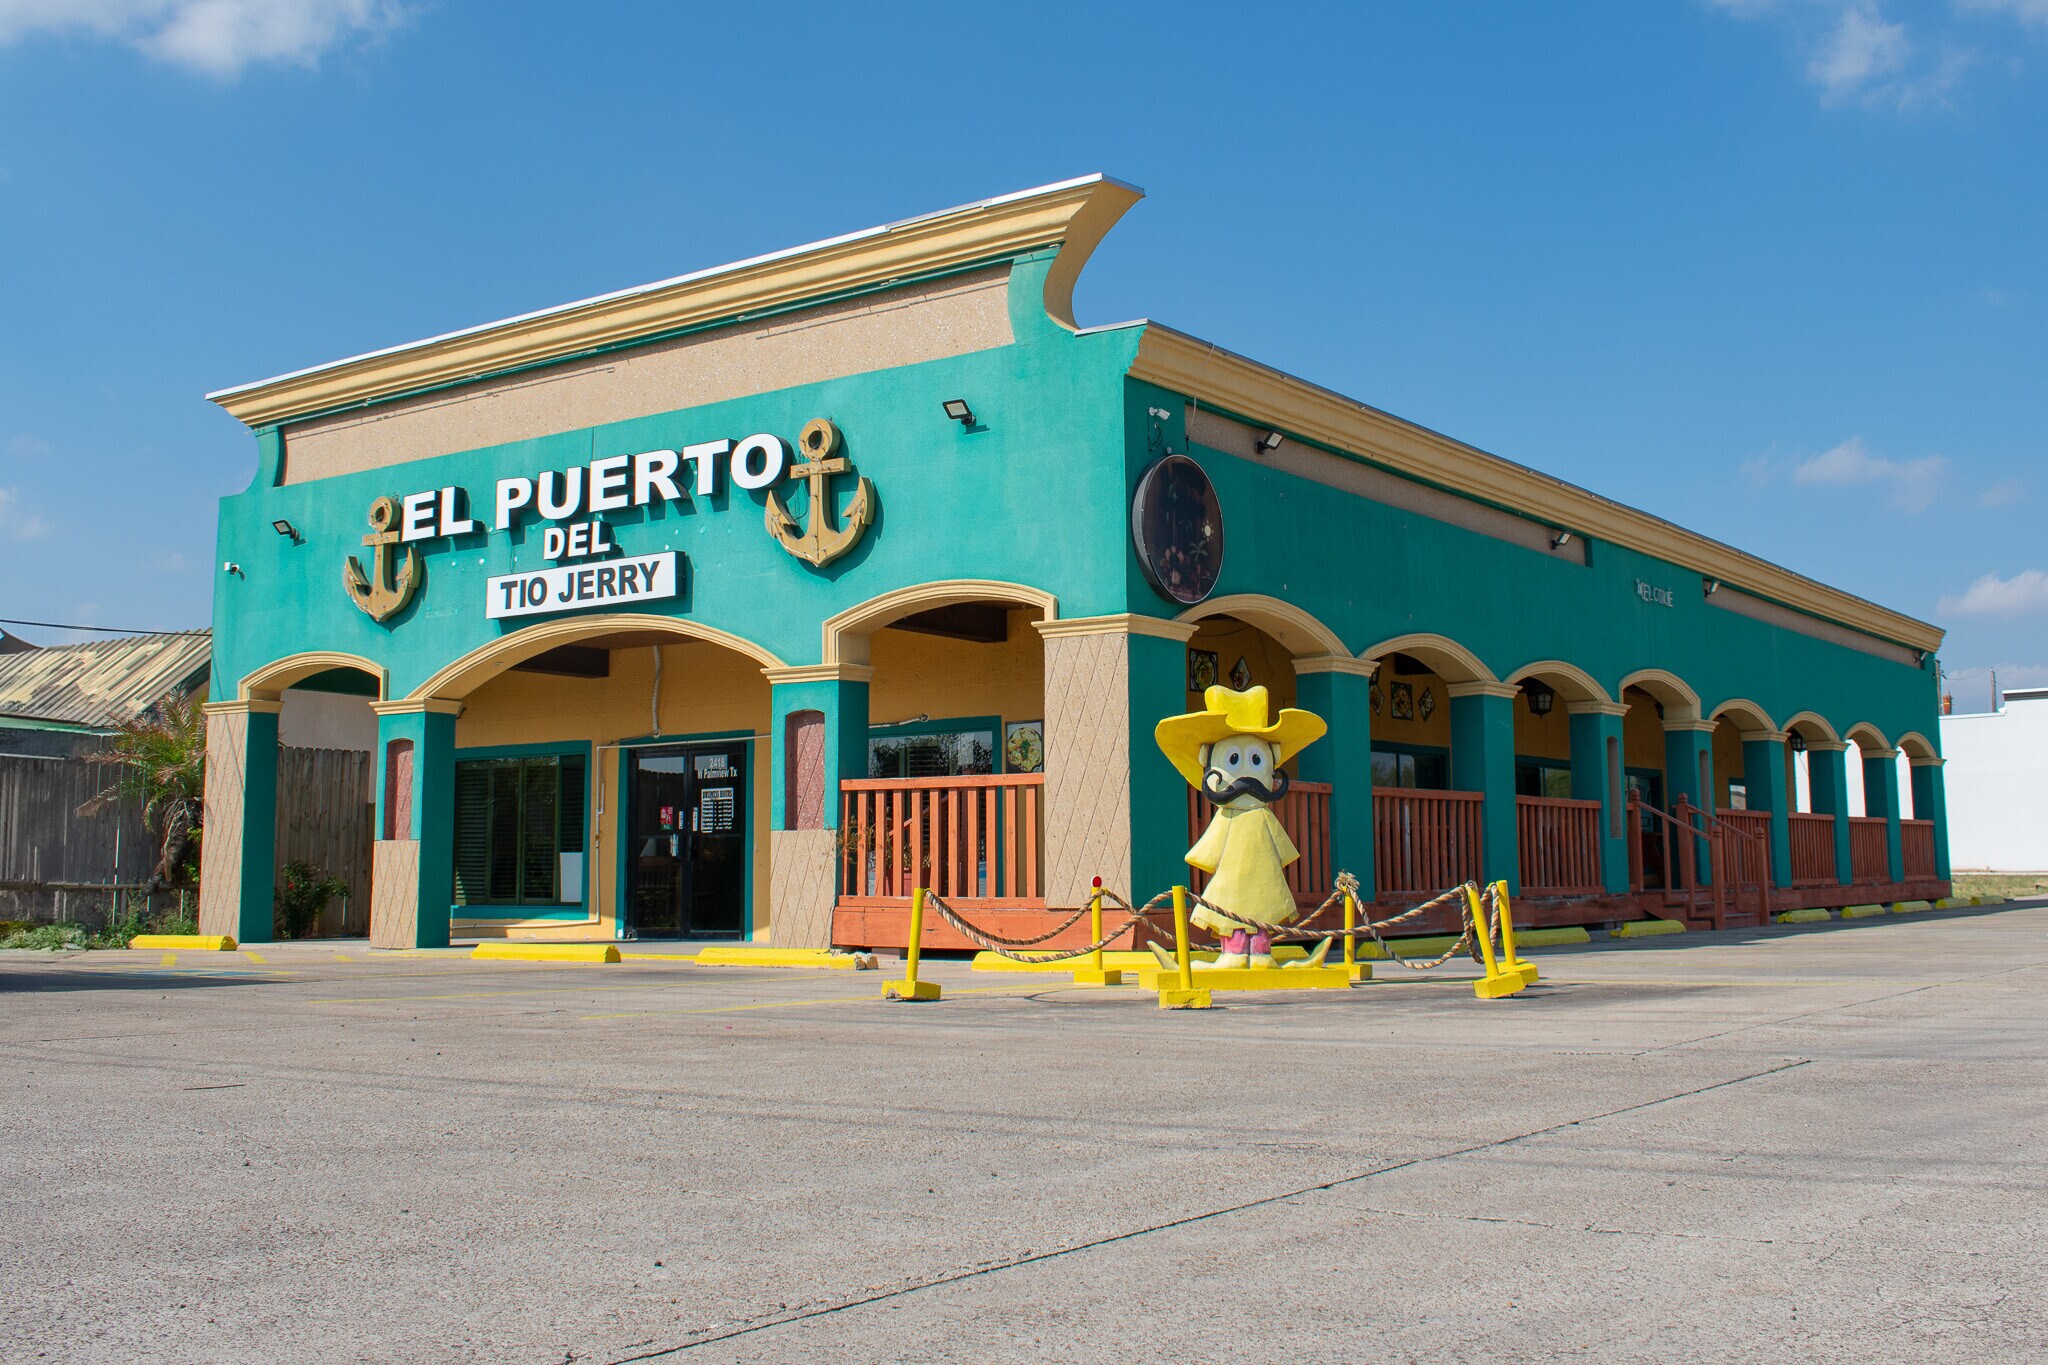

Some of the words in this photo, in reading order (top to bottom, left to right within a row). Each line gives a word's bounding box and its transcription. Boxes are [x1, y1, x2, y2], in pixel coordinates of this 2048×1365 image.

[402, 486, 475, 542] EL
[496, 433, 784, 530] PUERTO
[543, 521, 611, 561] DEL
[500, 576, 548, 610] TIO
[558, 560, 661, 603] JERRY
[709, 757, 725, 768] 2418
